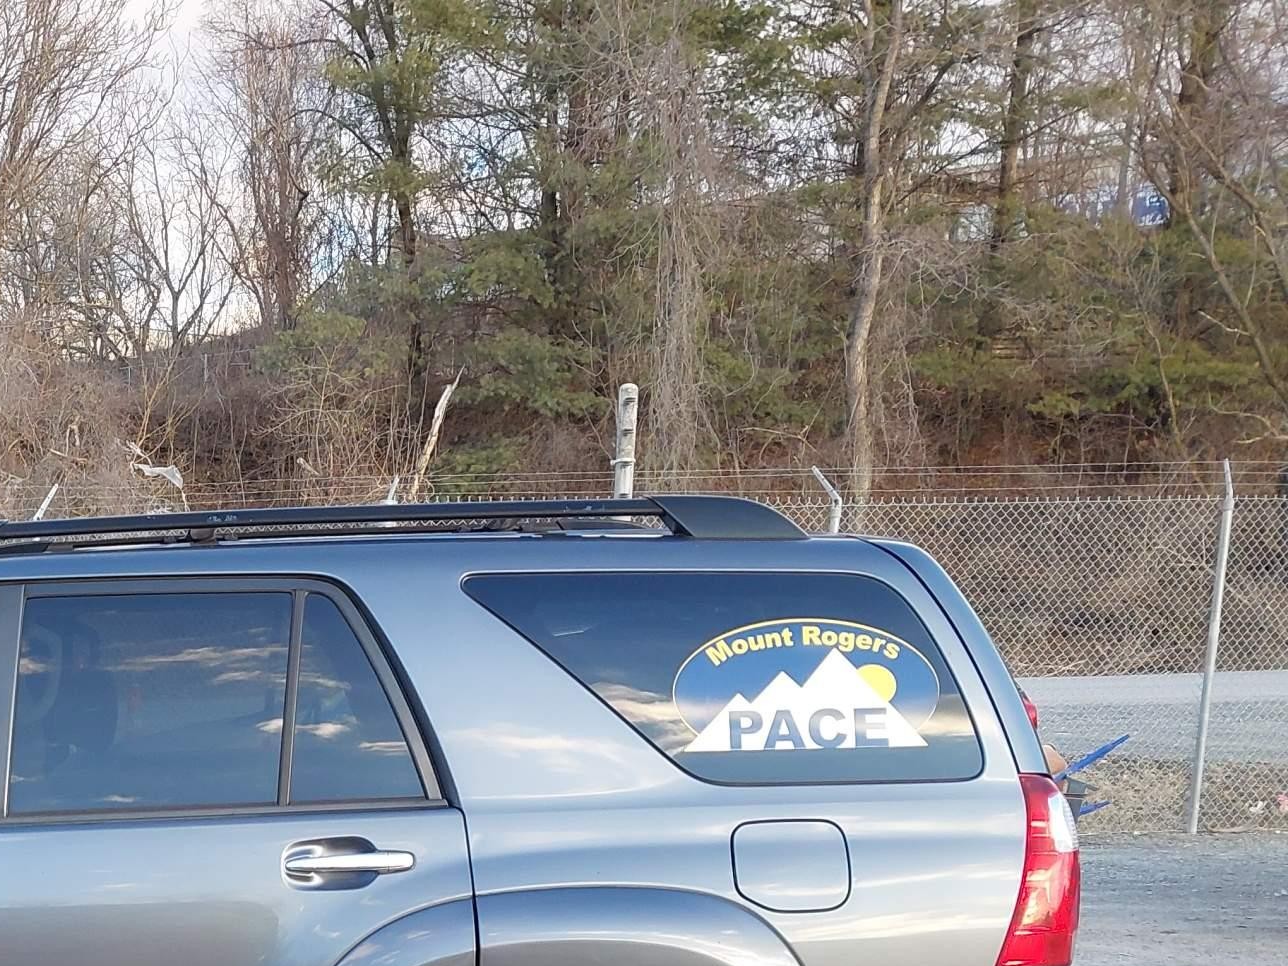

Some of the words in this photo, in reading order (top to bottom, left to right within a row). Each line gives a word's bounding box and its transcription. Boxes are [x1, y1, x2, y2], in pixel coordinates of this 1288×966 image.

[704, 628, 794, 666] Mount
[802, 625, 901, 660] Rogers
[728, 707, 890, 750] PACE
